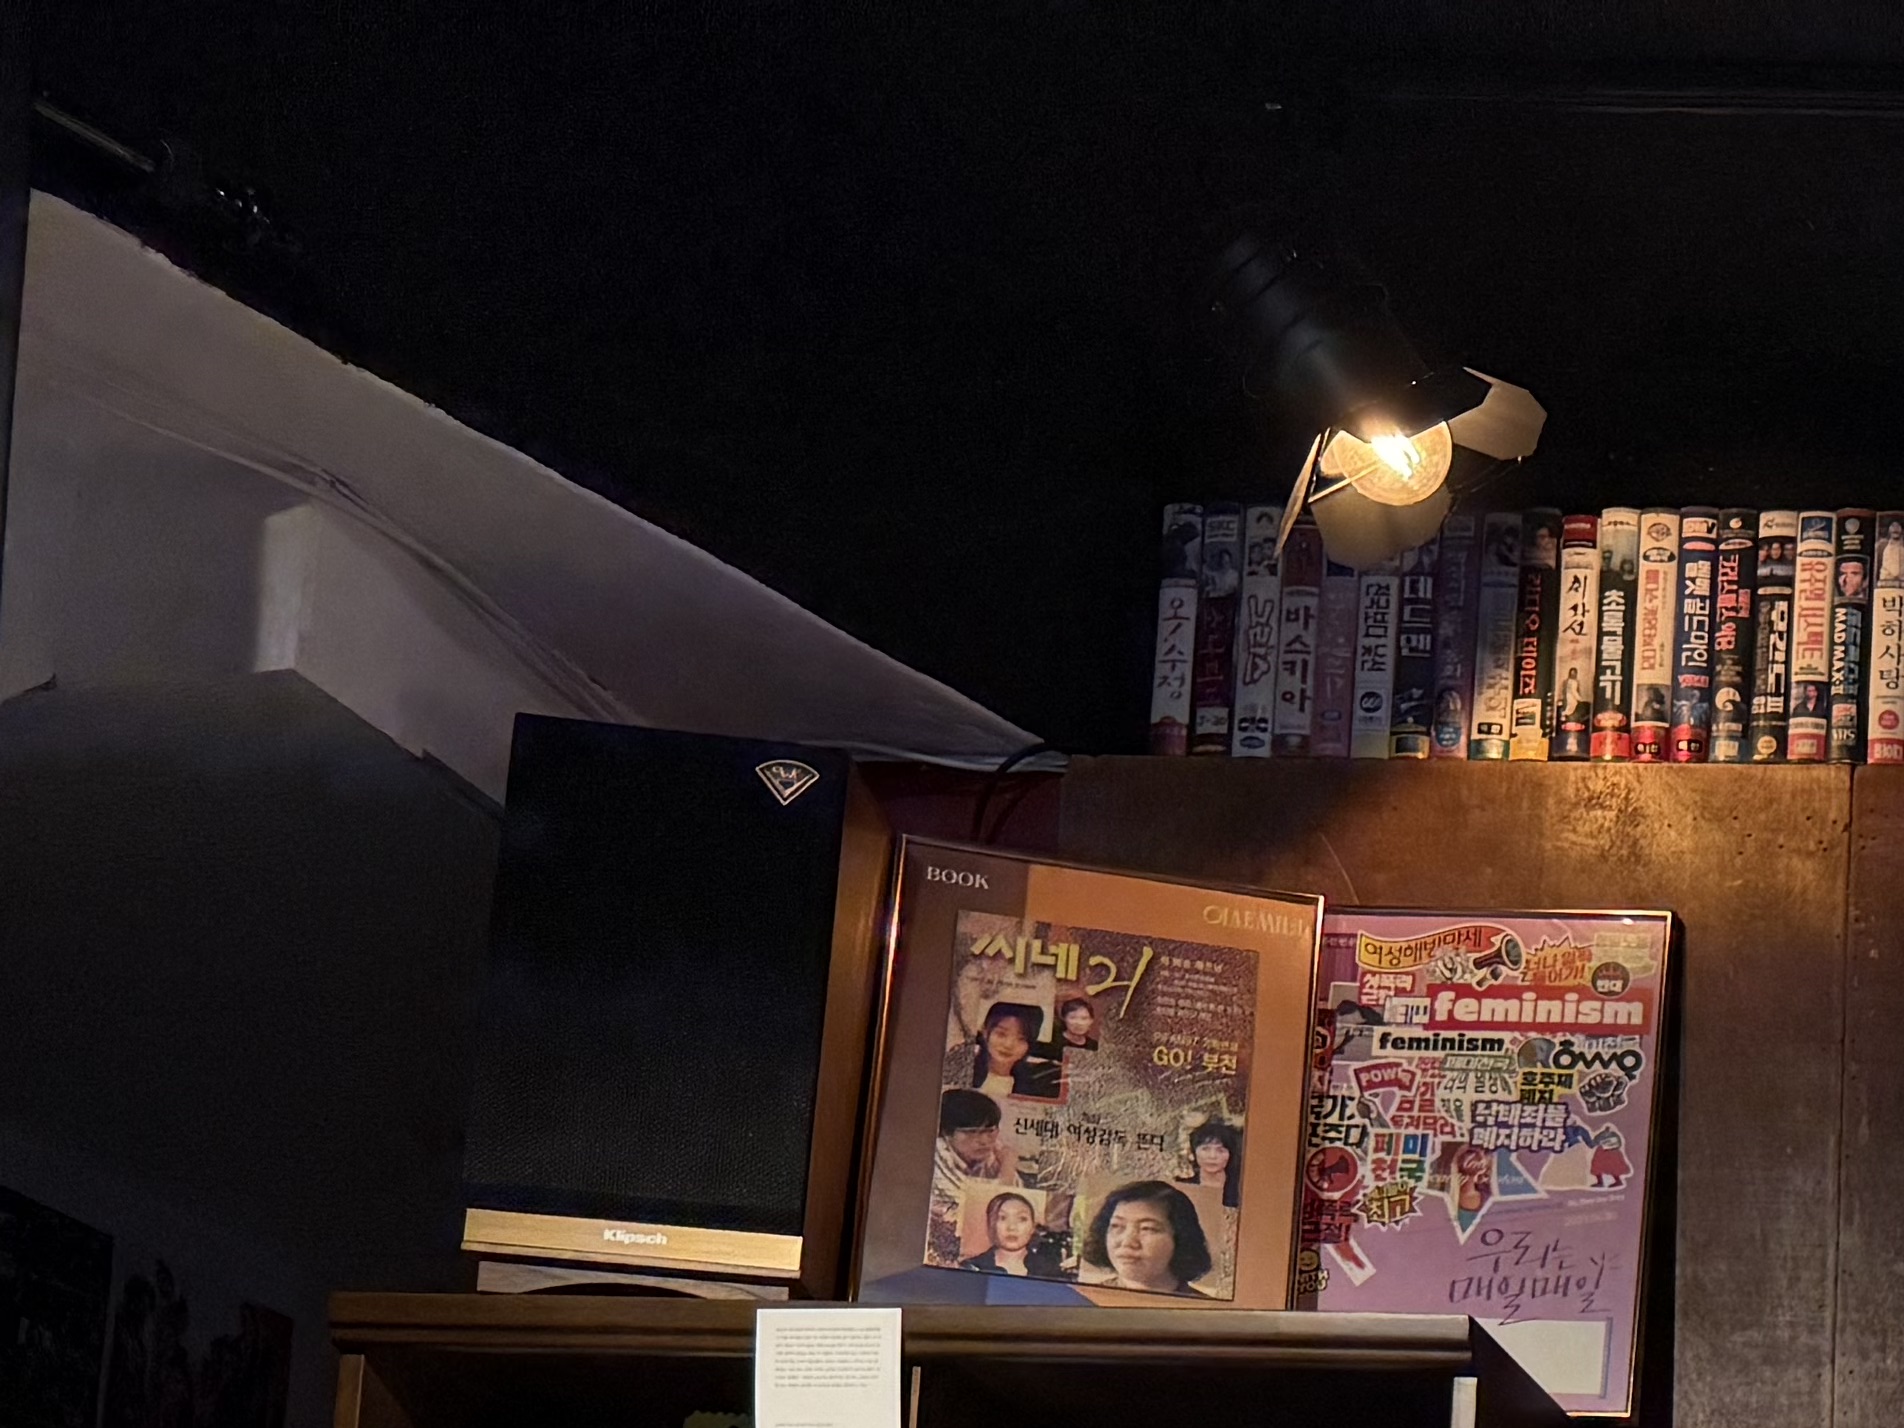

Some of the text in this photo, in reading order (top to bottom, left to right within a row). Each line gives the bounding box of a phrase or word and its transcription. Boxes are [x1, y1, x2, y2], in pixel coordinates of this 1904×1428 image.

[1401, 576, 1433, 658] 데드맨
[1681, 597, 1711, 668] 골드마인
[1599, 588, 1626, 706] 초록물고기
[1799, 605, 1825, 661] 서스펙트
[1281, 605, 1315, 714] 바스키아
[926, 866, 990, 890] BOOK
[970, 933, 1080, 981] 씨네
[1088, 945, 1154, 1020] 21
[1435, 992, 1644, 1025] feminism
[1378, 1032, 1506, 1051] feminism
[1152, 1046, 1237, 1075] GO! 부천
[1521, 1071, 1575, 1088] 호주제
[1013, 1117, 1060, 1139] 신세대
[1066, 1122, 1127, 1147] 여성감독
[1373, 1133, 1428, 1157] 페미
[1472, 1127, 1566, 1150] 폐지하라
[1370, 1158, 1427, 1182] 천국
[603, 1228, 668, 1246] Klipsch
[1466, 1227, 1578, 1272] 우리는
[1448, 1257, 1613, 1326] 매일매일
